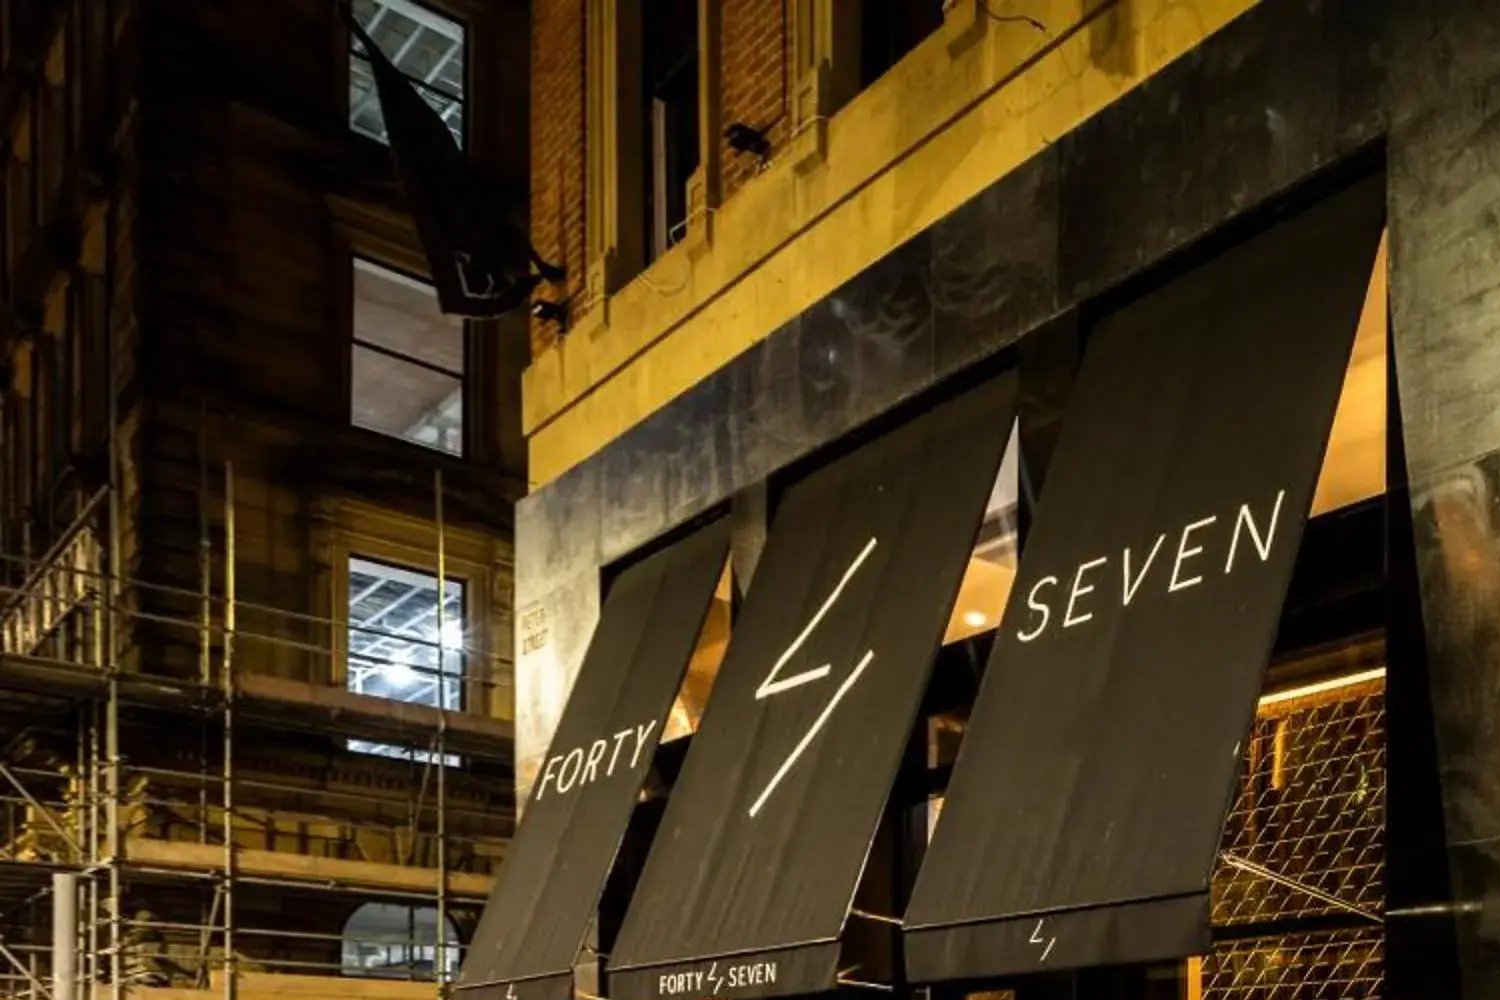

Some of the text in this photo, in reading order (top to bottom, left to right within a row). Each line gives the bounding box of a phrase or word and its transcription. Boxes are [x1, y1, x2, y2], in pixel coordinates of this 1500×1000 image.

[1017, 489, 1285, 642] SEVEN
[536, 719, 657, 801] FORTY
[659, 962, 777, 995] FORTY SEVEN
